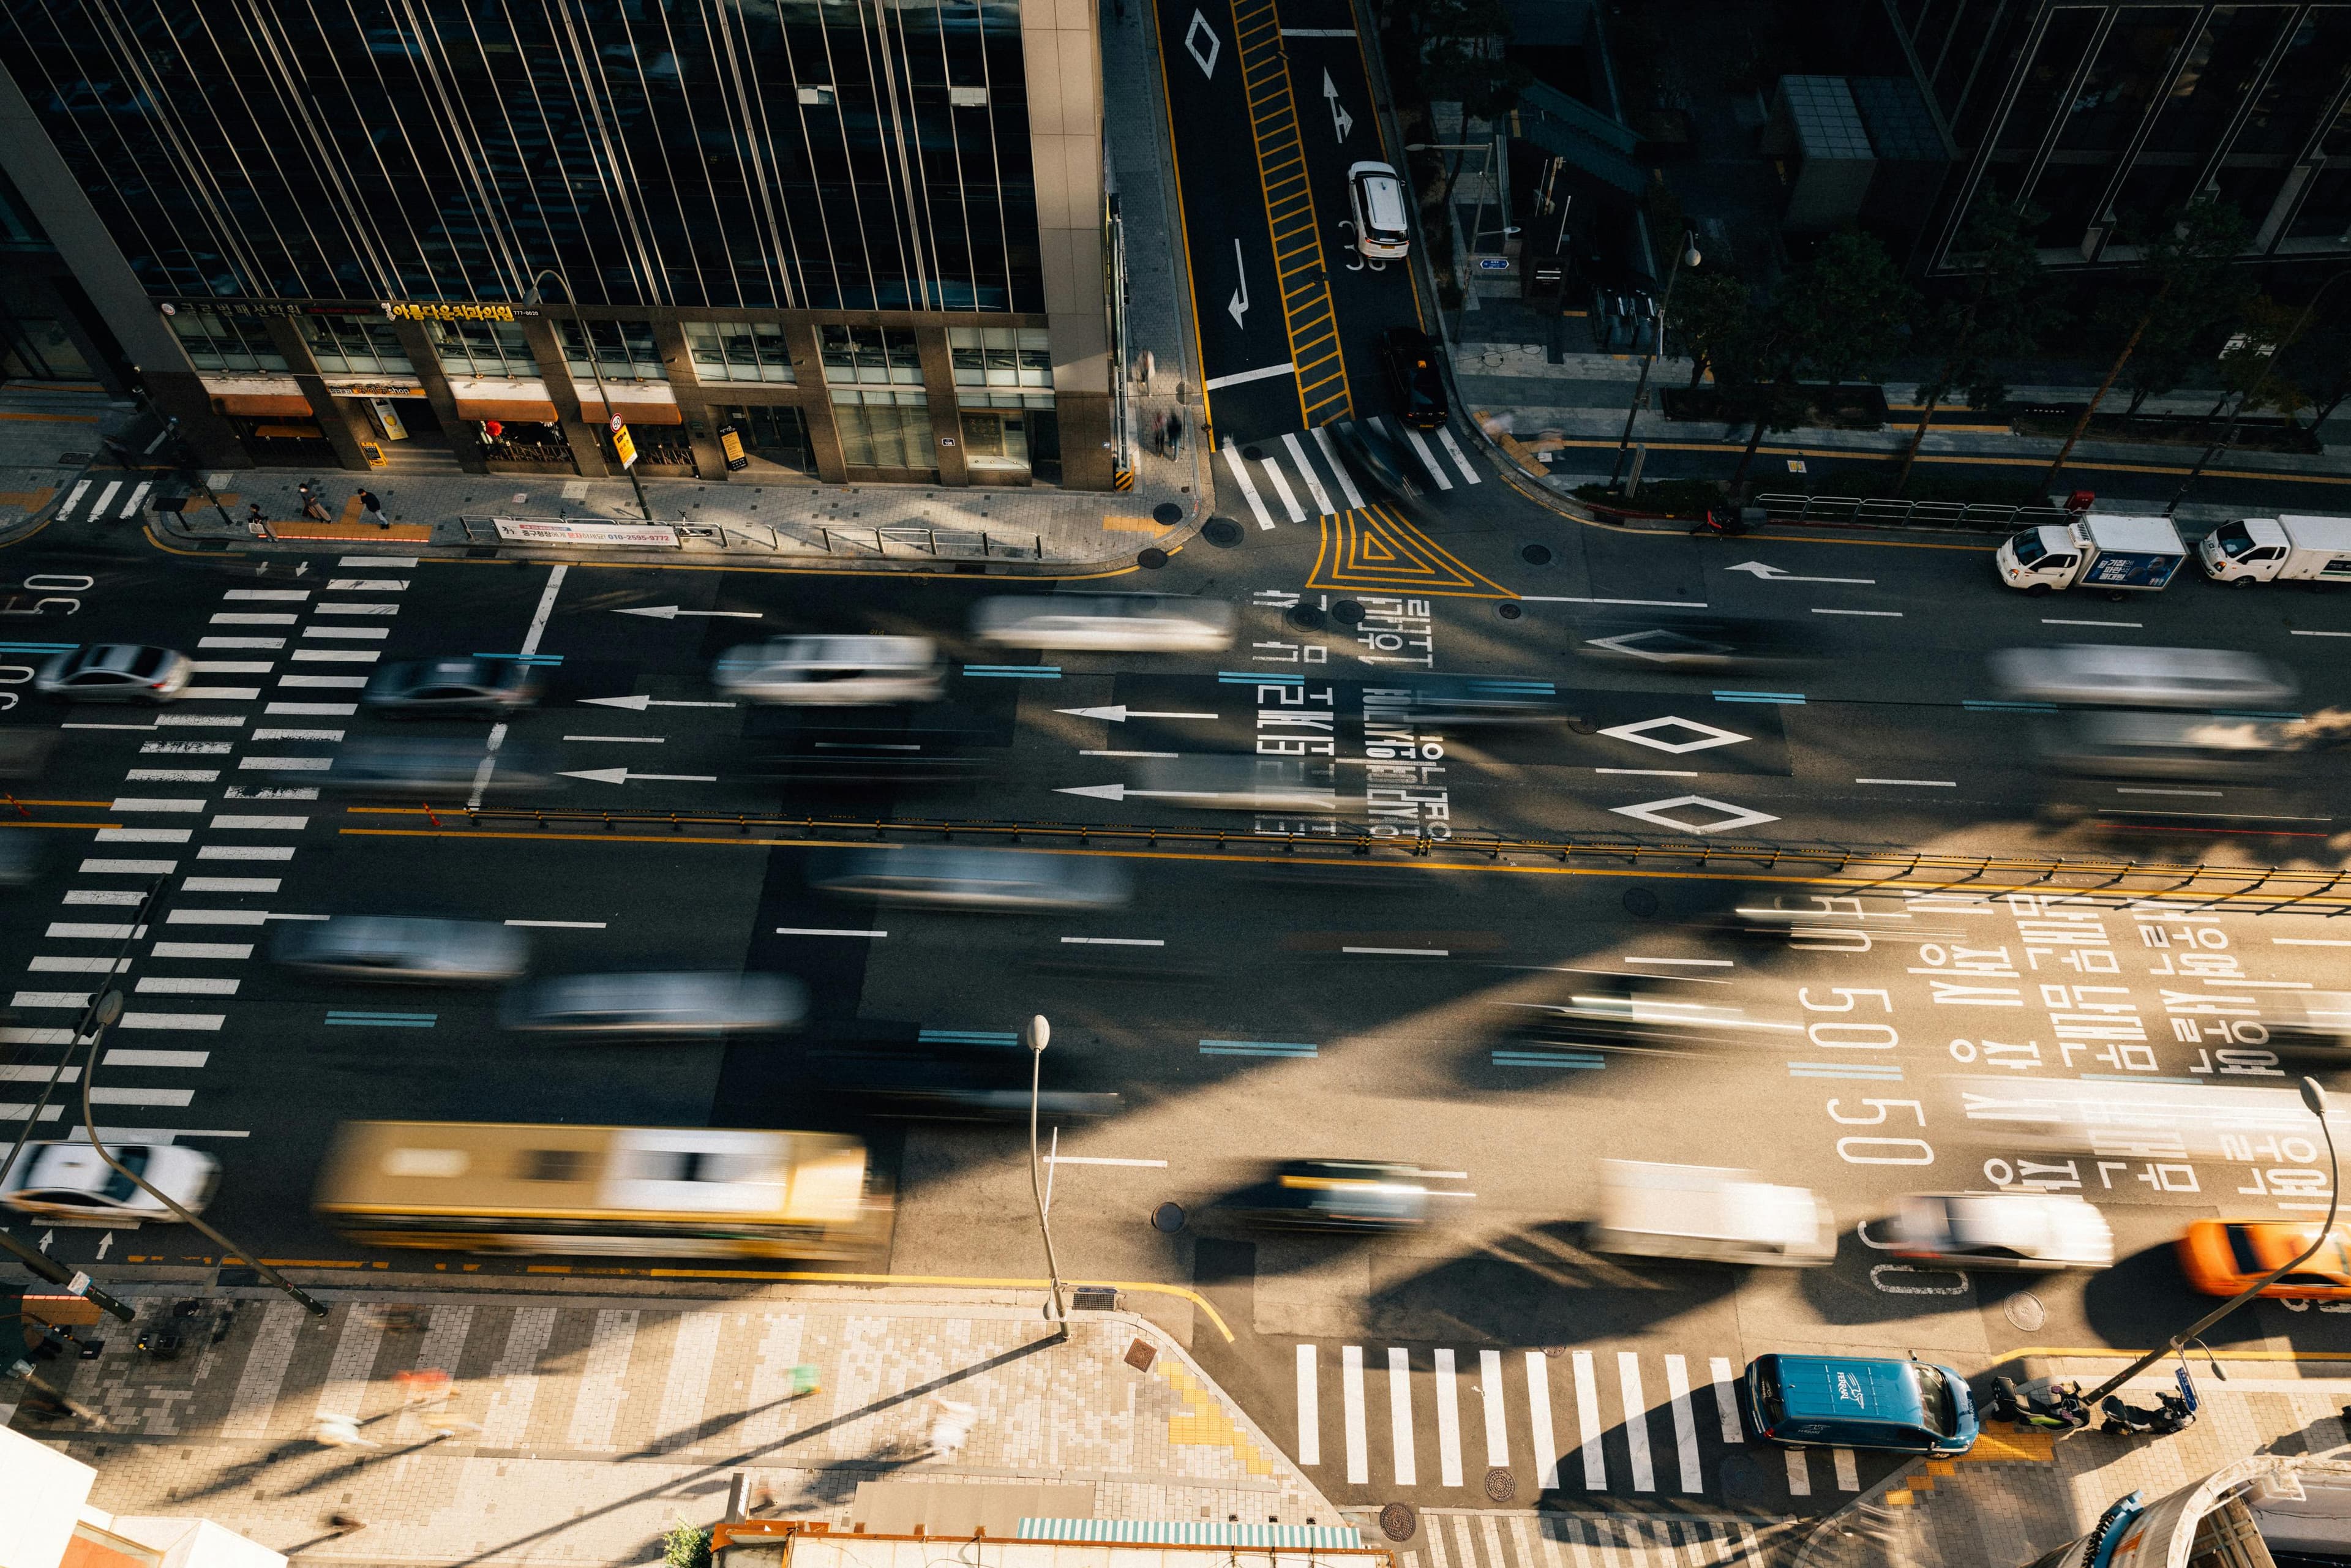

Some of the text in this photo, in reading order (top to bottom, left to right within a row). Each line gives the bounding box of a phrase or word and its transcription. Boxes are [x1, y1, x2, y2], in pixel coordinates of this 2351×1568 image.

[182, 302, 304, 318] 글로벌패션학원
[393, 304, 514, 322] 아름다운치과의원
[613, 417, 621, 429] 50
[1357, 596, 1433, 668] 1호터널
[1256, 685, 1335, 756] 퇴계로
[2007, 893, 2121, 973] 남대문
[2127, 898, 2246, 978] 서울역
[1799, 987, 1899, 1049] 50
[2039, 985, 2159, 1071] 남대문
[2160, 989, 2285, 1076] 서울역
[1826, 1098, 1935, 1165] 50
[1837, 1371, 1849, 1400] FERRARI
